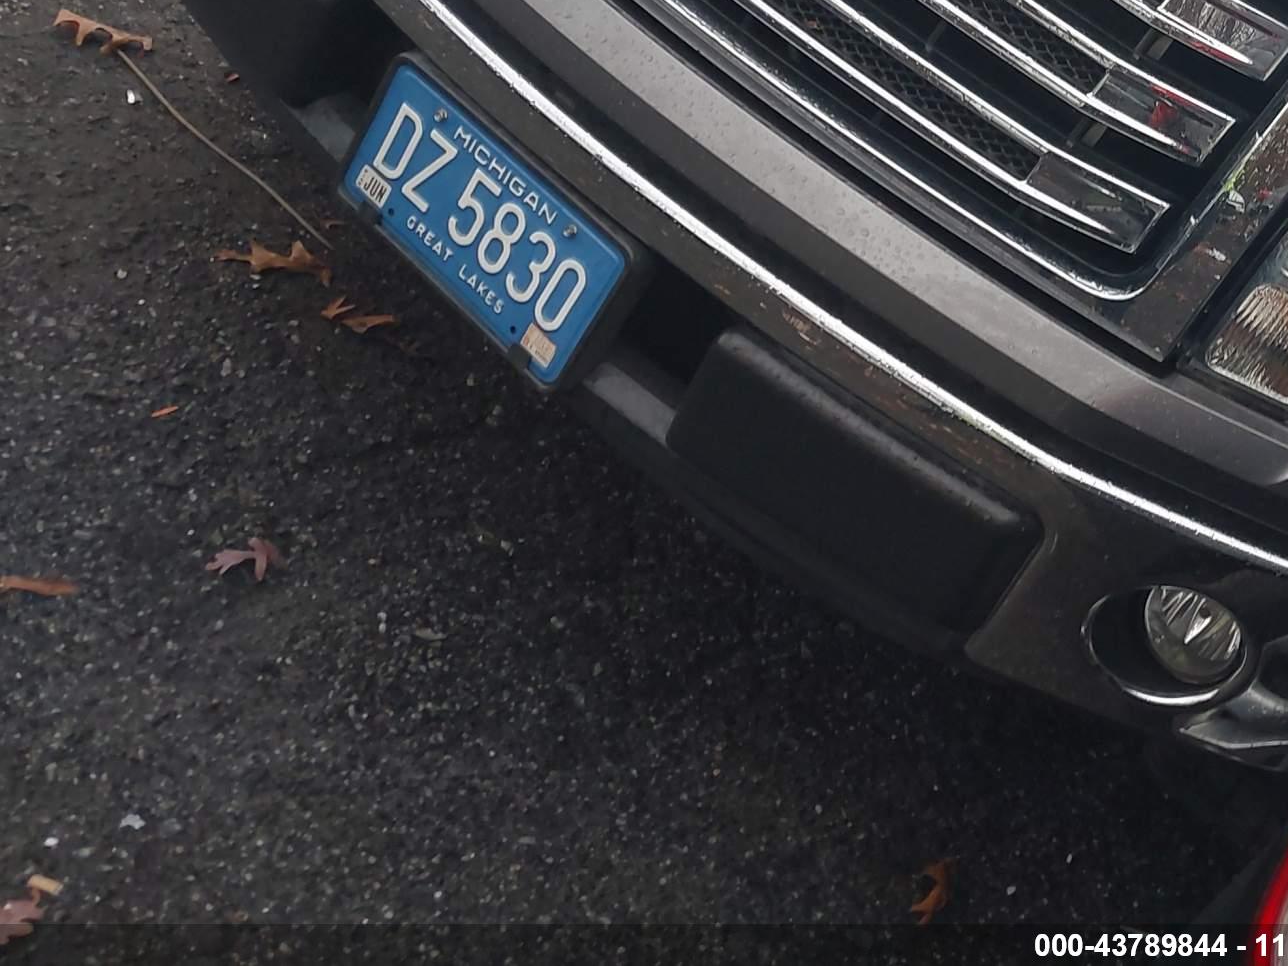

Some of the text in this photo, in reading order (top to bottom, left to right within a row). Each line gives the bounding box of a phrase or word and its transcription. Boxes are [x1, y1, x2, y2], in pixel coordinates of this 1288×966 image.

[363, 176, 388, 203] JUN
[373, 102, 587, 332] DZ 5830
[454, 125, 558, 225] MICHIGAN
[406, 216, 505, 315] GREAT LAKES
